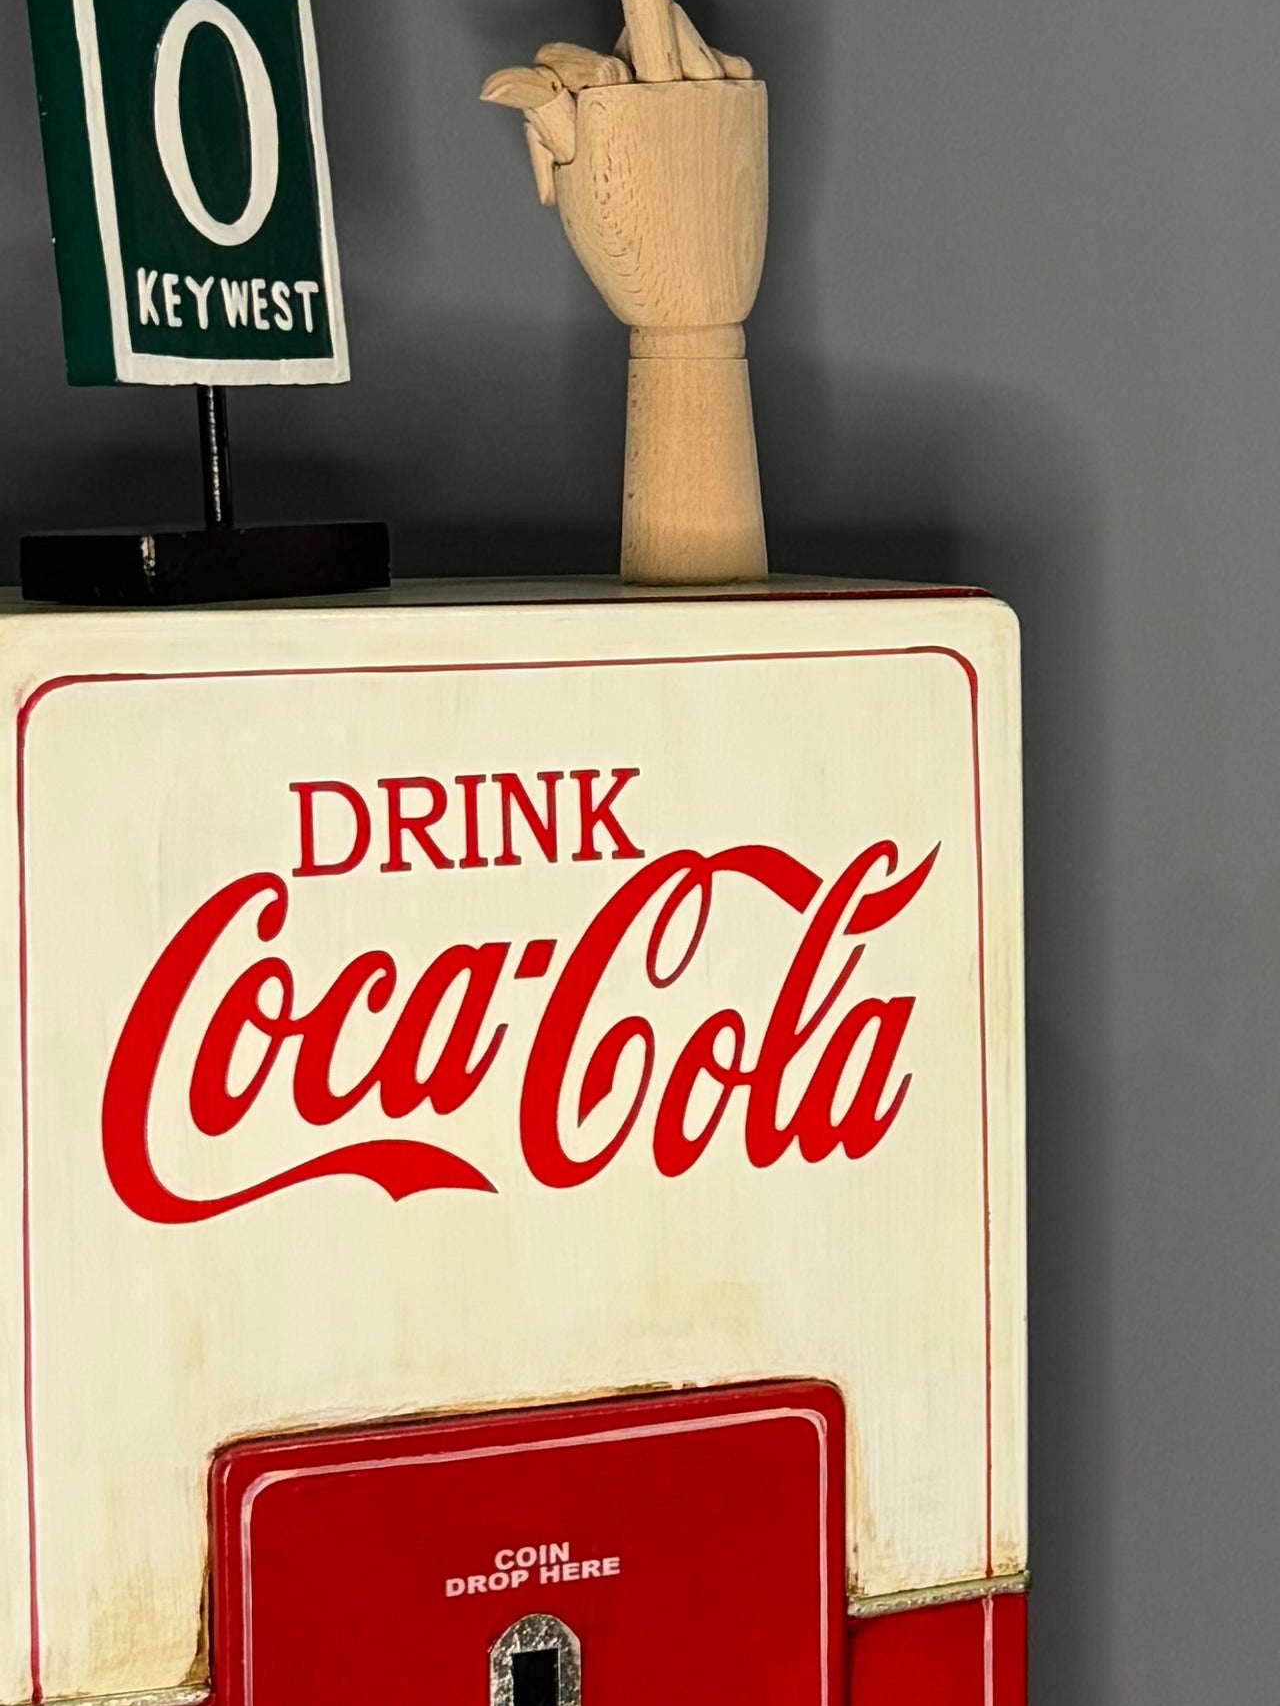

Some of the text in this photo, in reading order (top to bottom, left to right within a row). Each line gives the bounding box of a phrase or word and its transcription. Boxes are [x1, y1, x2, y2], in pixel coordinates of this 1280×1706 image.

[289, 768, 646, 878] DRINK
[101, 839, 941, 1225] Coca-Cola
[445, 1556, 621, 1598] DROP HERE
[494, 1541, 570, 1571] COIN
